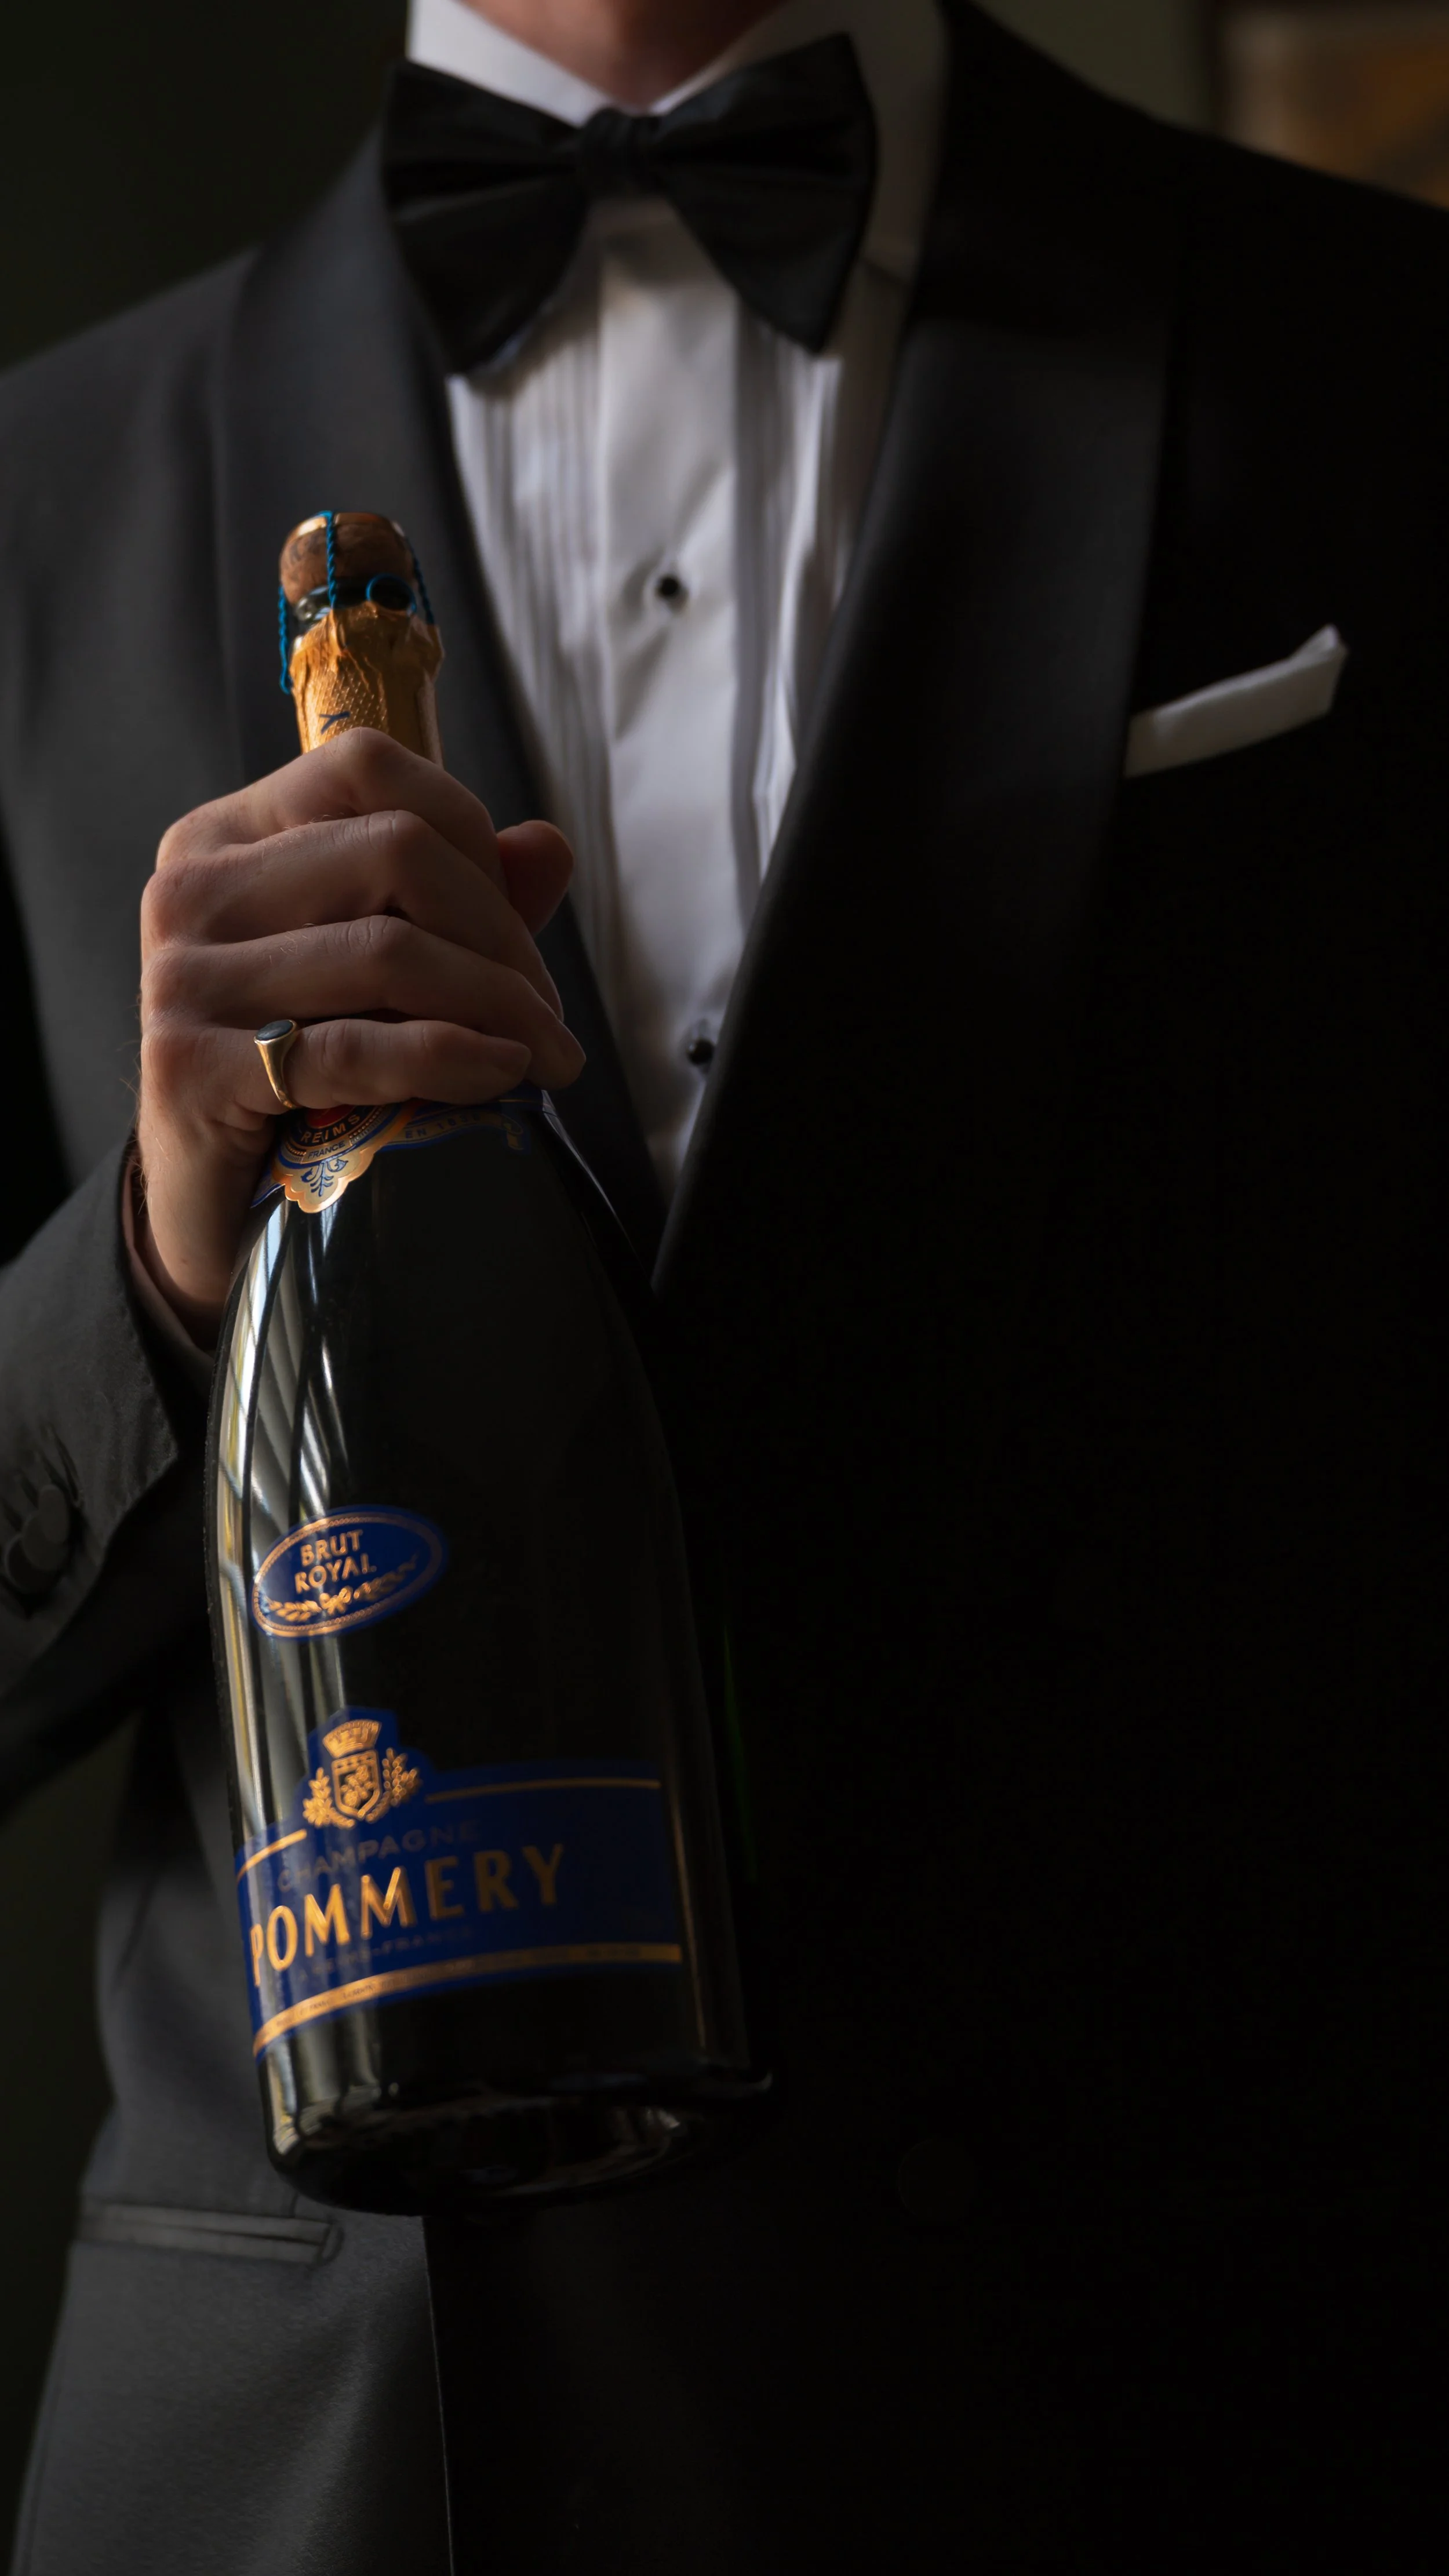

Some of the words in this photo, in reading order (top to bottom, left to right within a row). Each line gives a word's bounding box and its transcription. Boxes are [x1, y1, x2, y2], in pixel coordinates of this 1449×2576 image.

[300, 1113, 361, 1144] REIMS
[405, 1127, 427, 1138] EN
[308, 1140, 345, 1159] FRANCE
[300, 1529, 364, 1567] BRUT
[294, 1552, 377, 1594] ROYAL
[277, 1818, 480, 1893] CHAMPAGNE
[249, 1843, 565, 1988] POMMERY
